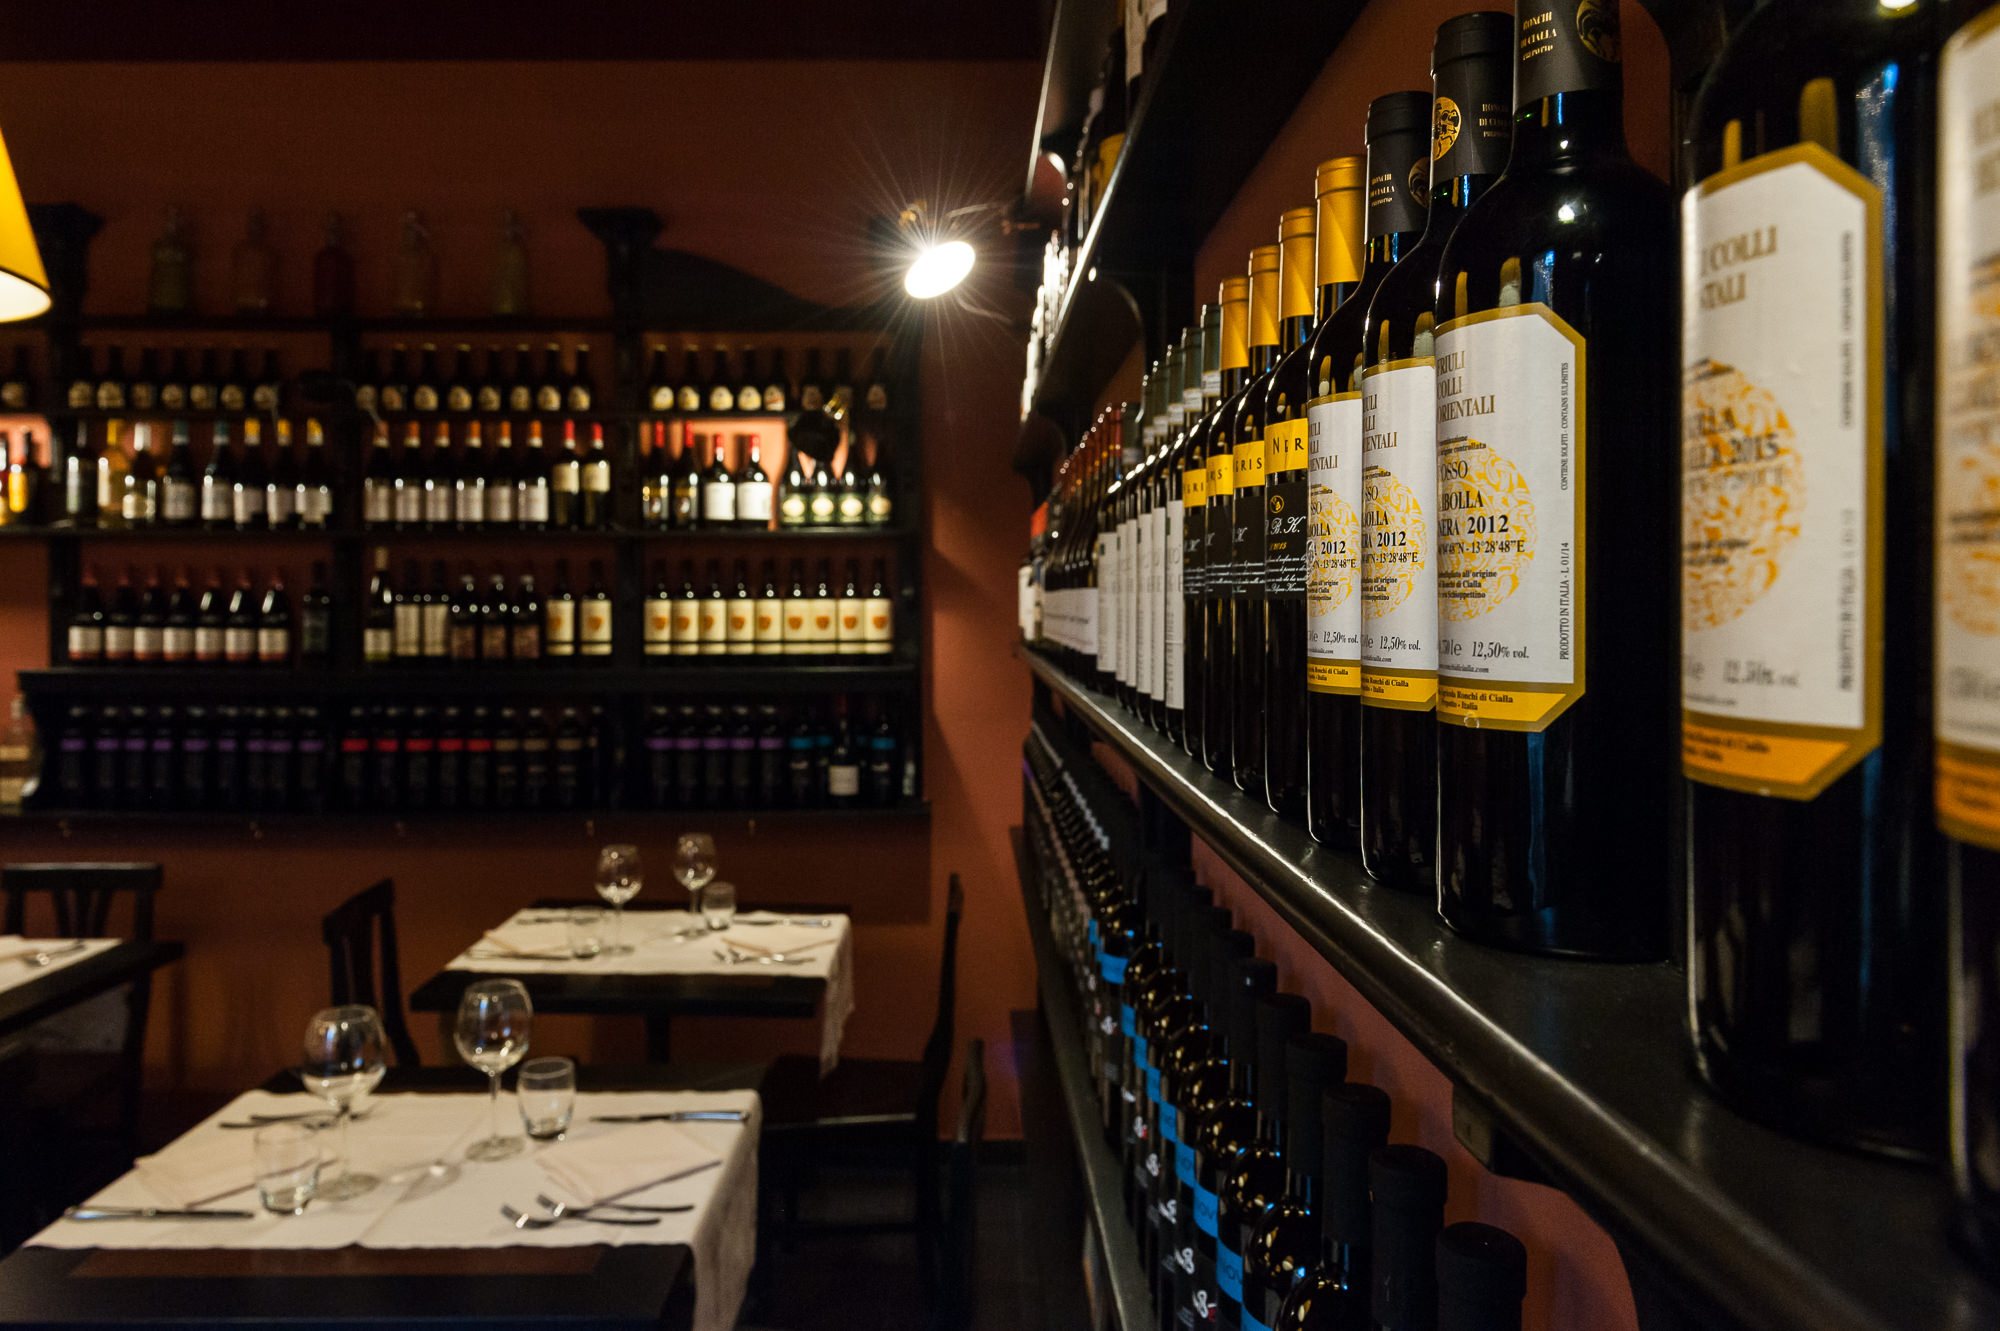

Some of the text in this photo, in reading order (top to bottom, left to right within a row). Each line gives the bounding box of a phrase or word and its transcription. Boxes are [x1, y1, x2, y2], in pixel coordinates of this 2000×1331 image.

[1467, 514, 1509, 535] 2012
[1321, 540, 1346, 555] 2012
[1377, 531, 1407, 548] 2012
[1560, 542, 1569, 566] 01/14
[1462, 580, 1482, 588] Cialla
[1559, 580, 1569, 606] ITALIA
[1559, 607, 1569, 617] IN
[1380, 635, 1421, 652] 12,50% vol.
[1559, 618, 1569, 660] PRODOTTO
[1472, 641, 1511, 661] 12,50%
[1512, 646, 1530, 659] vol.
[1461, 702, 1479, 711] Italia
[1488, 694, 1514, 704] Cialla
